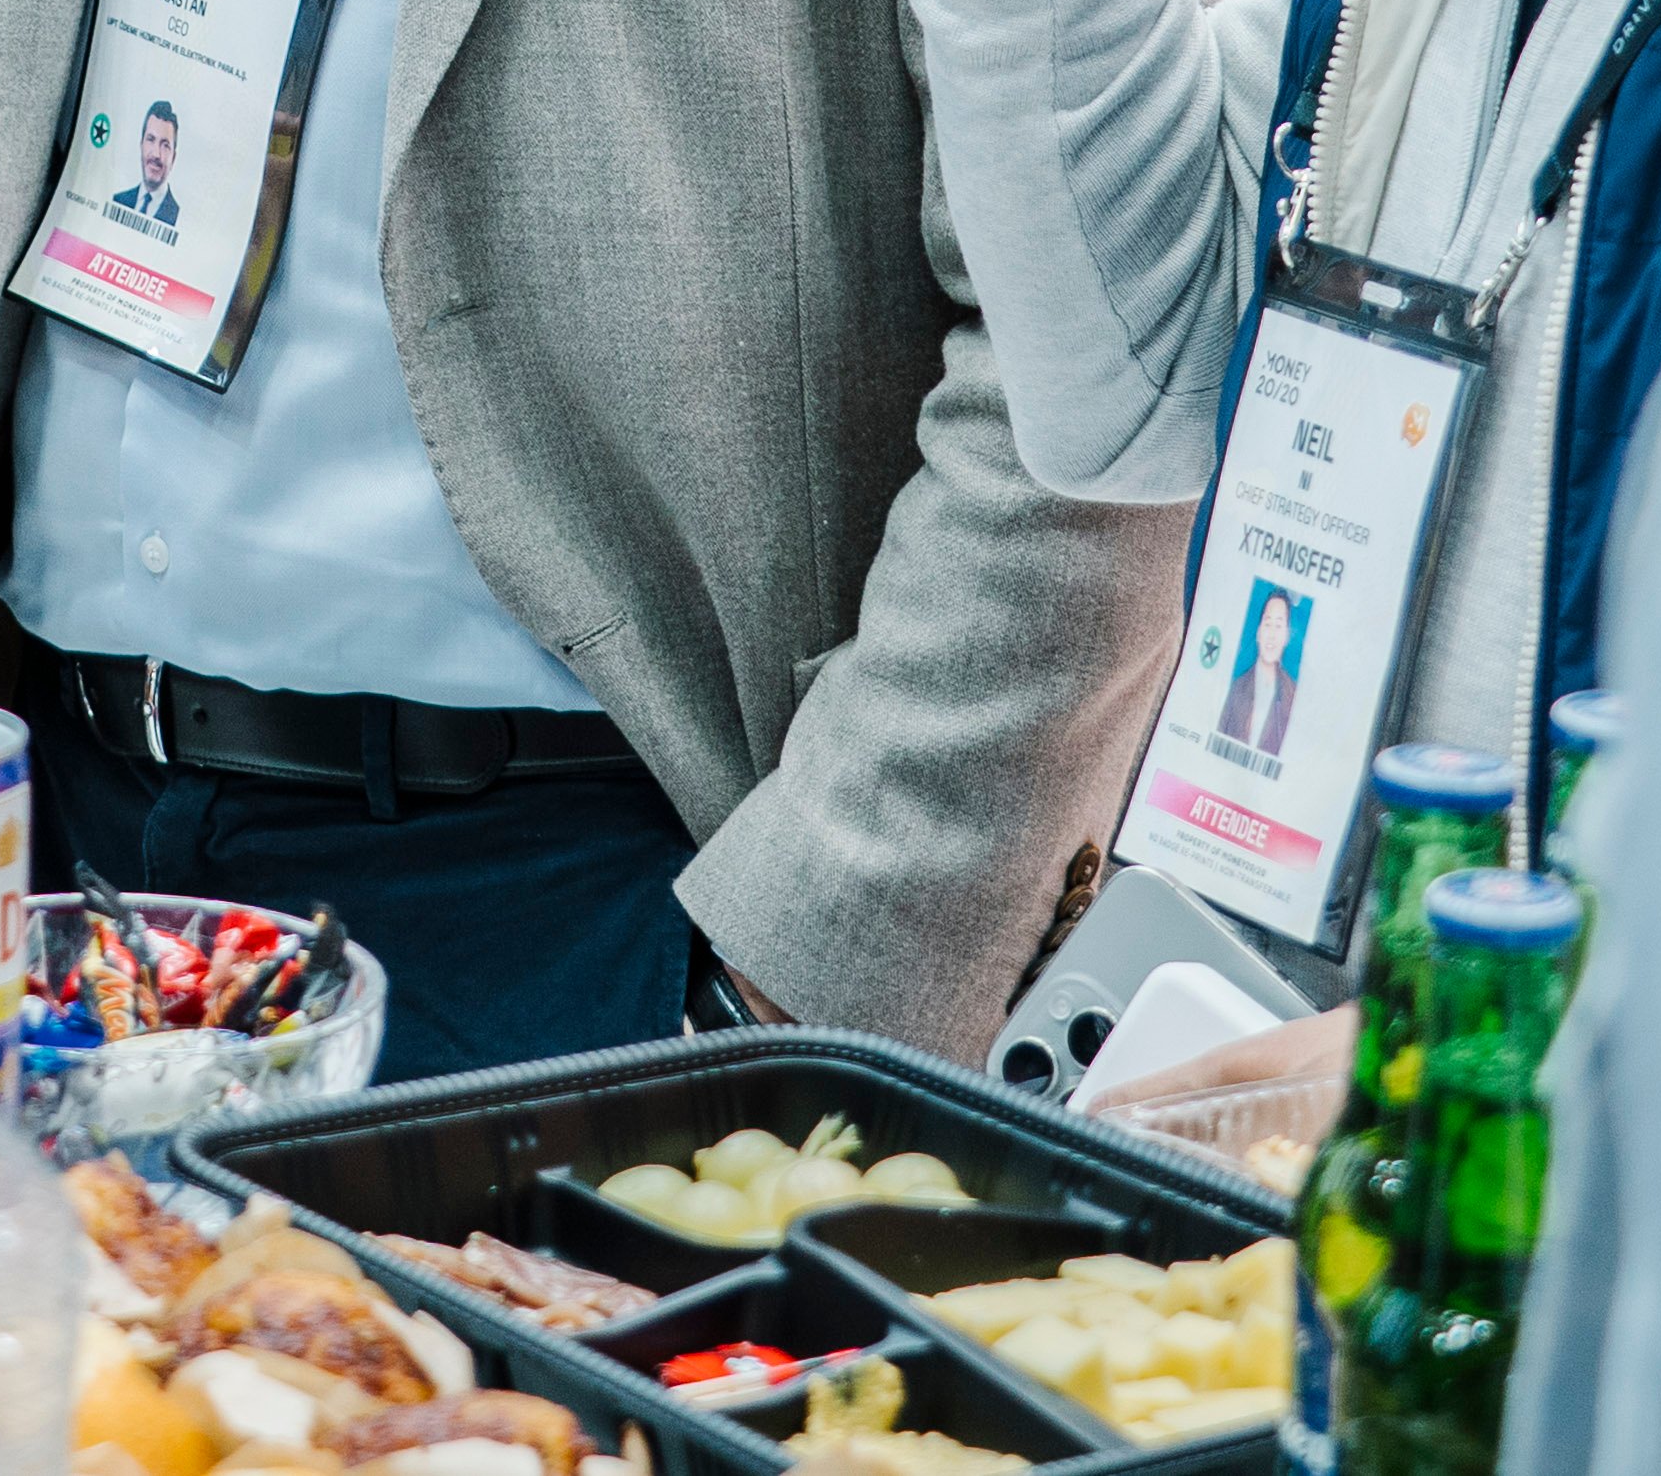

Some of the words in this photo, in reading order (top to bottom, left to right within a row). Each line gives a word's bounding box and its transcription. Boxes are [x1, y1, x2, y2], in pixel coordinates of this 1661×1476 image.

[168, 16, 189, 36] CEO
[71, 276, 106, 297] PROPERTY
[107, 292, 116, 301] OF
[117, 296, 162, 322] MONEY20/20
[87, 252, 169, 301] ATTENDEE
[1262, 350, 1311, 383] MONEY
[1255, 375, 1299, 406] 20/20
[1292, 419, 1335, 464] NEIL
[1298, 470, 1313, 492] NI
[1235, 480, 1265, 506] CHIEF
[1265, 491, 1319, 526] STRATEGY
[1320, 513, 1370, 545] OFFICER
[1239, 523, 1345, 589] XTRANSFER
[1176, 829, 1211, 850] PROPERTY
[1189, 795, 1270, 848] ATTENDEE
